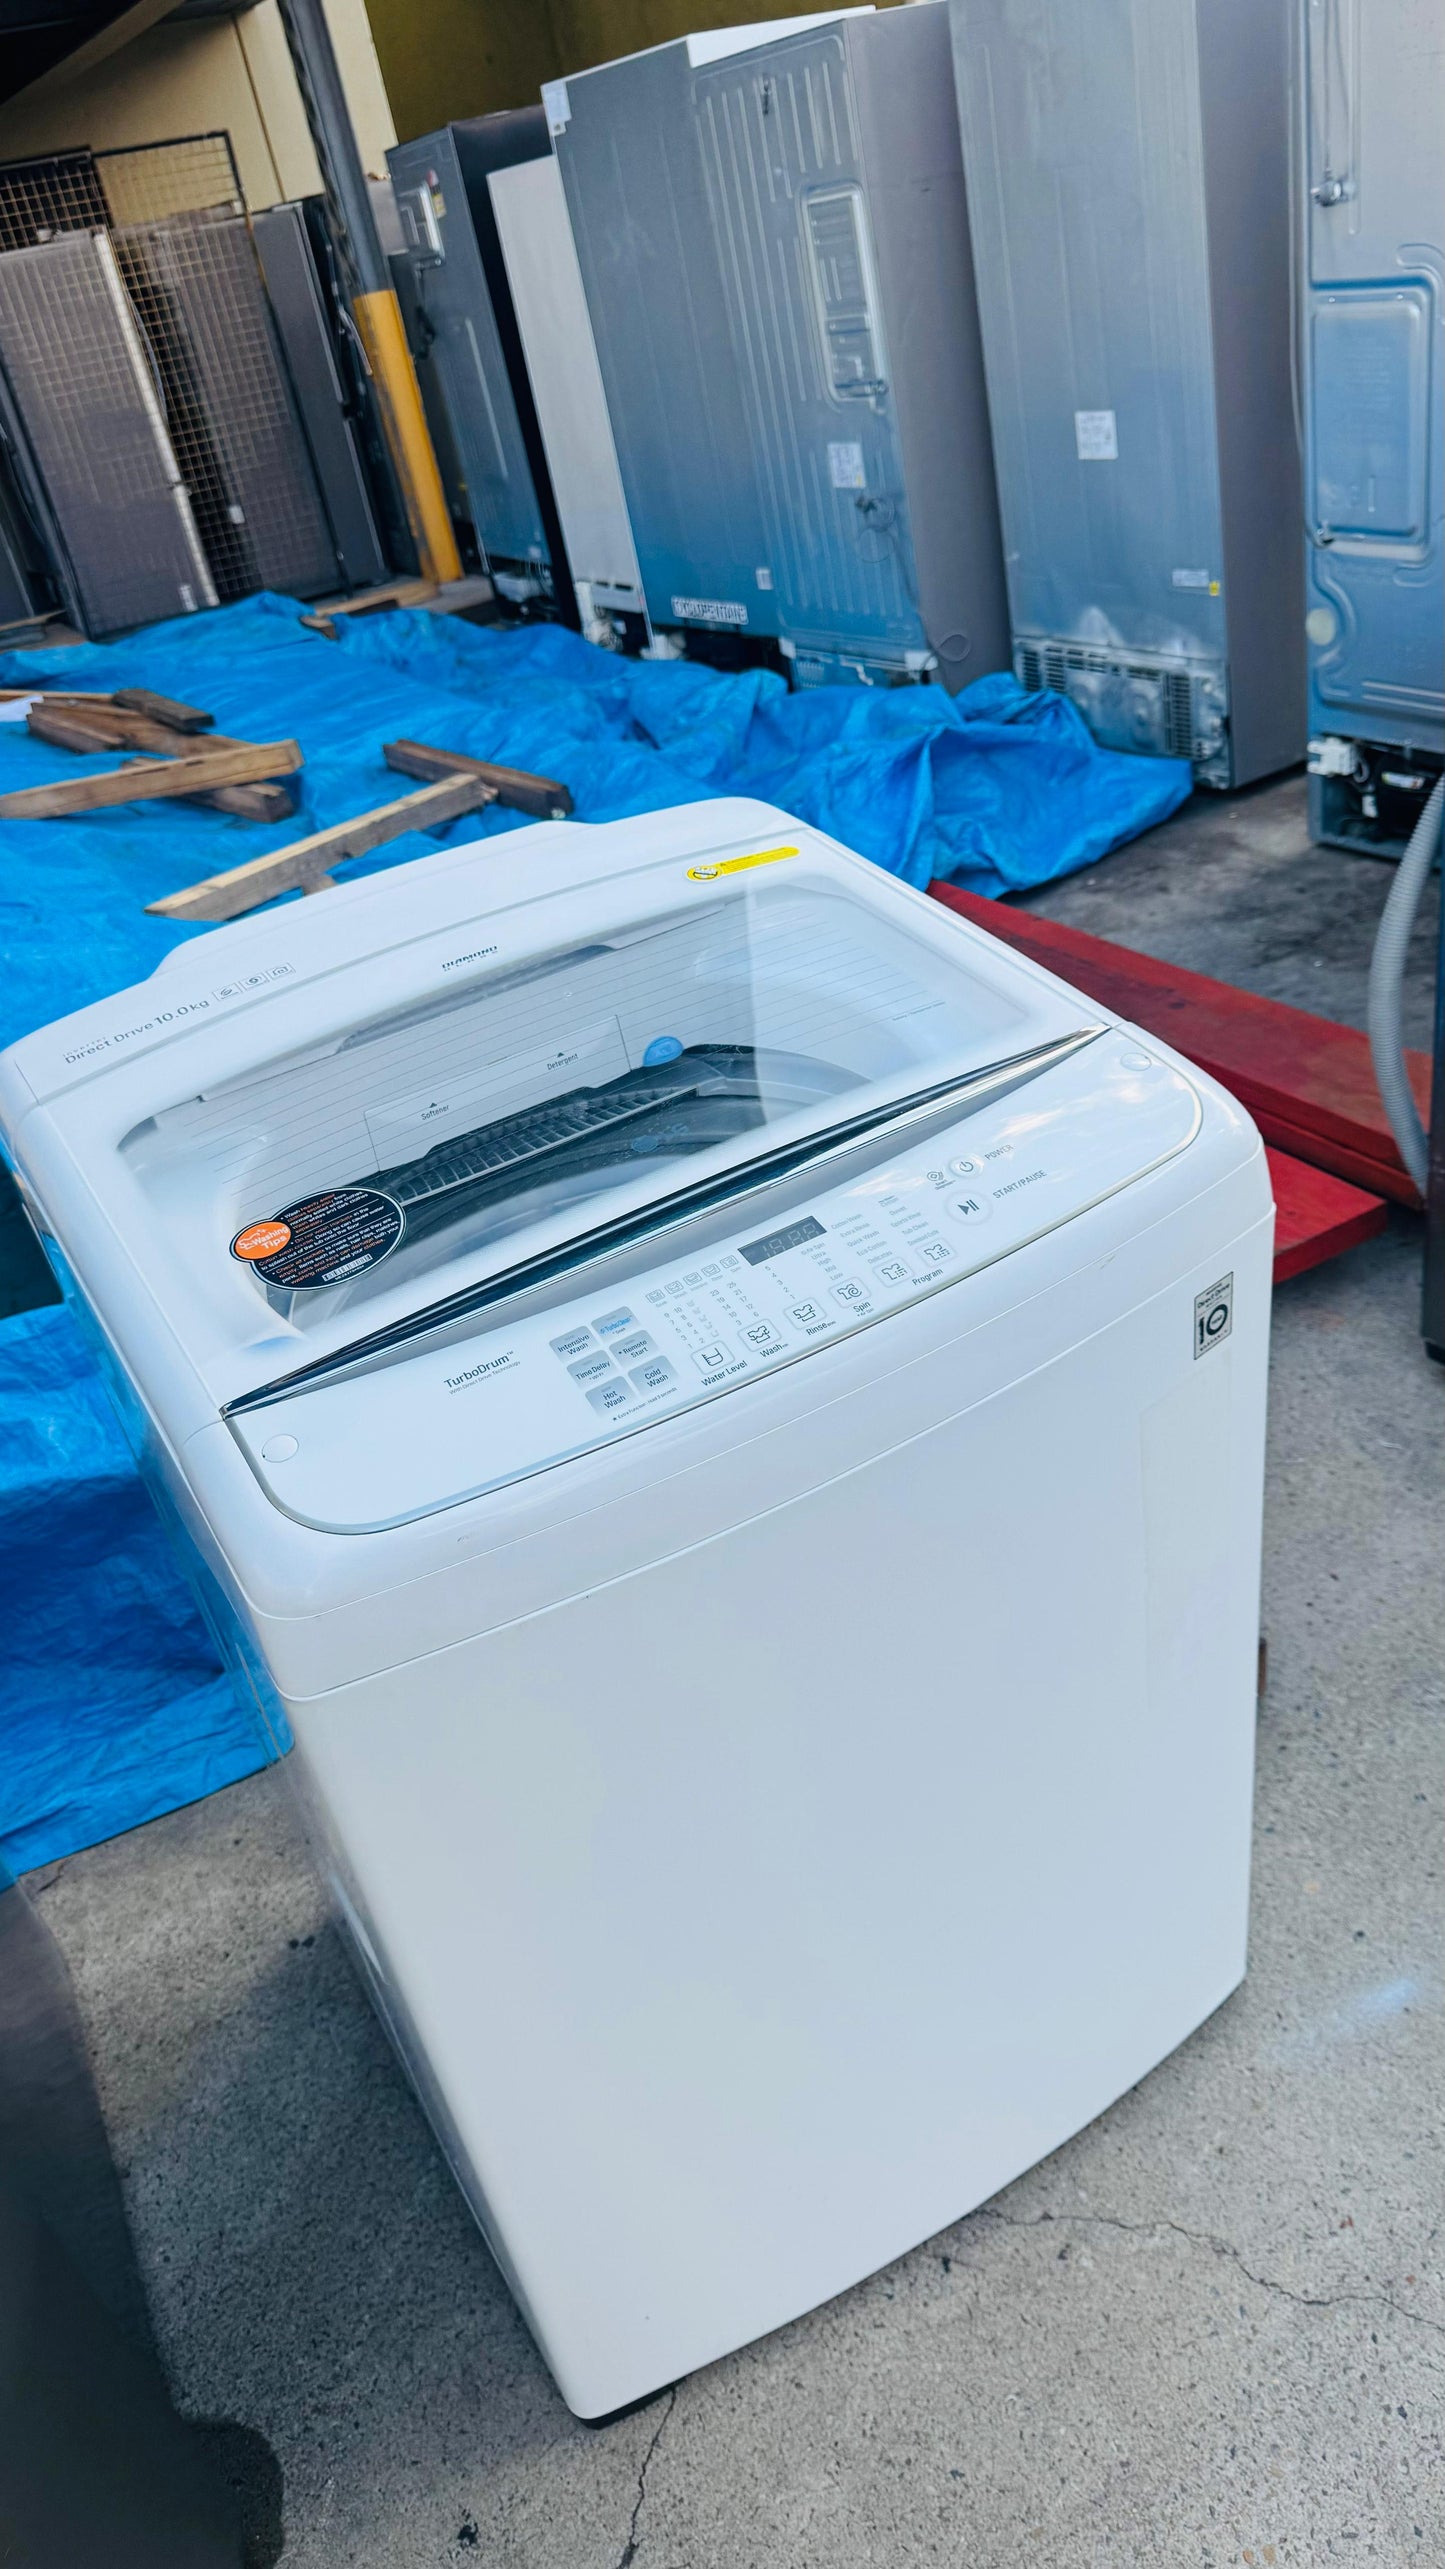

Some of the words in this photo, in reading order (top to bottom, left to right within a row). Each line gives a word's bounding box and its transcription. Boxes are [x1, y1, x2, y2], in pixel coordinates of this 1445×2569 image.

[65, 1040, 112, 1064] Direct
[114, 1022, 154, 1043] Drive
[546, 1052, 579, 1071] Detergent
[421, 1104, 450, 1121] Softener
[984, 1144, 1014, 1161] POWER
[992, 1169, 1048, 1199] START/PAUSE
[252, 1225, 290, 1247] Washing
[261, 1235, 288, 1250] Tips
[314, 1230, 333, 1241] Doing
[911, 1268, 944, 1286] Program
[710, 1288, 719, 1297] 23
[733, 1288, 742, 1296] 21
[722, 1303, 731, 1311] 14
[728, 1310, 737, 1318] 10
[853, 1301, 871, 1313] Spin
[805, 1321, 828, 1336] Rinse
[1198, 1303, 1229, 1346] 10
[557, 1334, 590, 1353] Intensive
[567, 1342, 589, 1355] Wash
[622, 1339, 648, 1355] Remote
[760, 1343, 783, 1358] Wash
[630, 1346, 649, 1359] Start
[575, 1368, 592, 1381] Time
[591, 1360, 611, 1374] Delay
[644, 1367, 662, 1381] Cold
[701, 1371, 726, 1387] Water
[725, 1359, 748, 1375] Level
[646, 1373, 669, 1388] Wash
[603, 1389, 618, 1401] Hot
[604, 1395, 626, 1409] Wash
